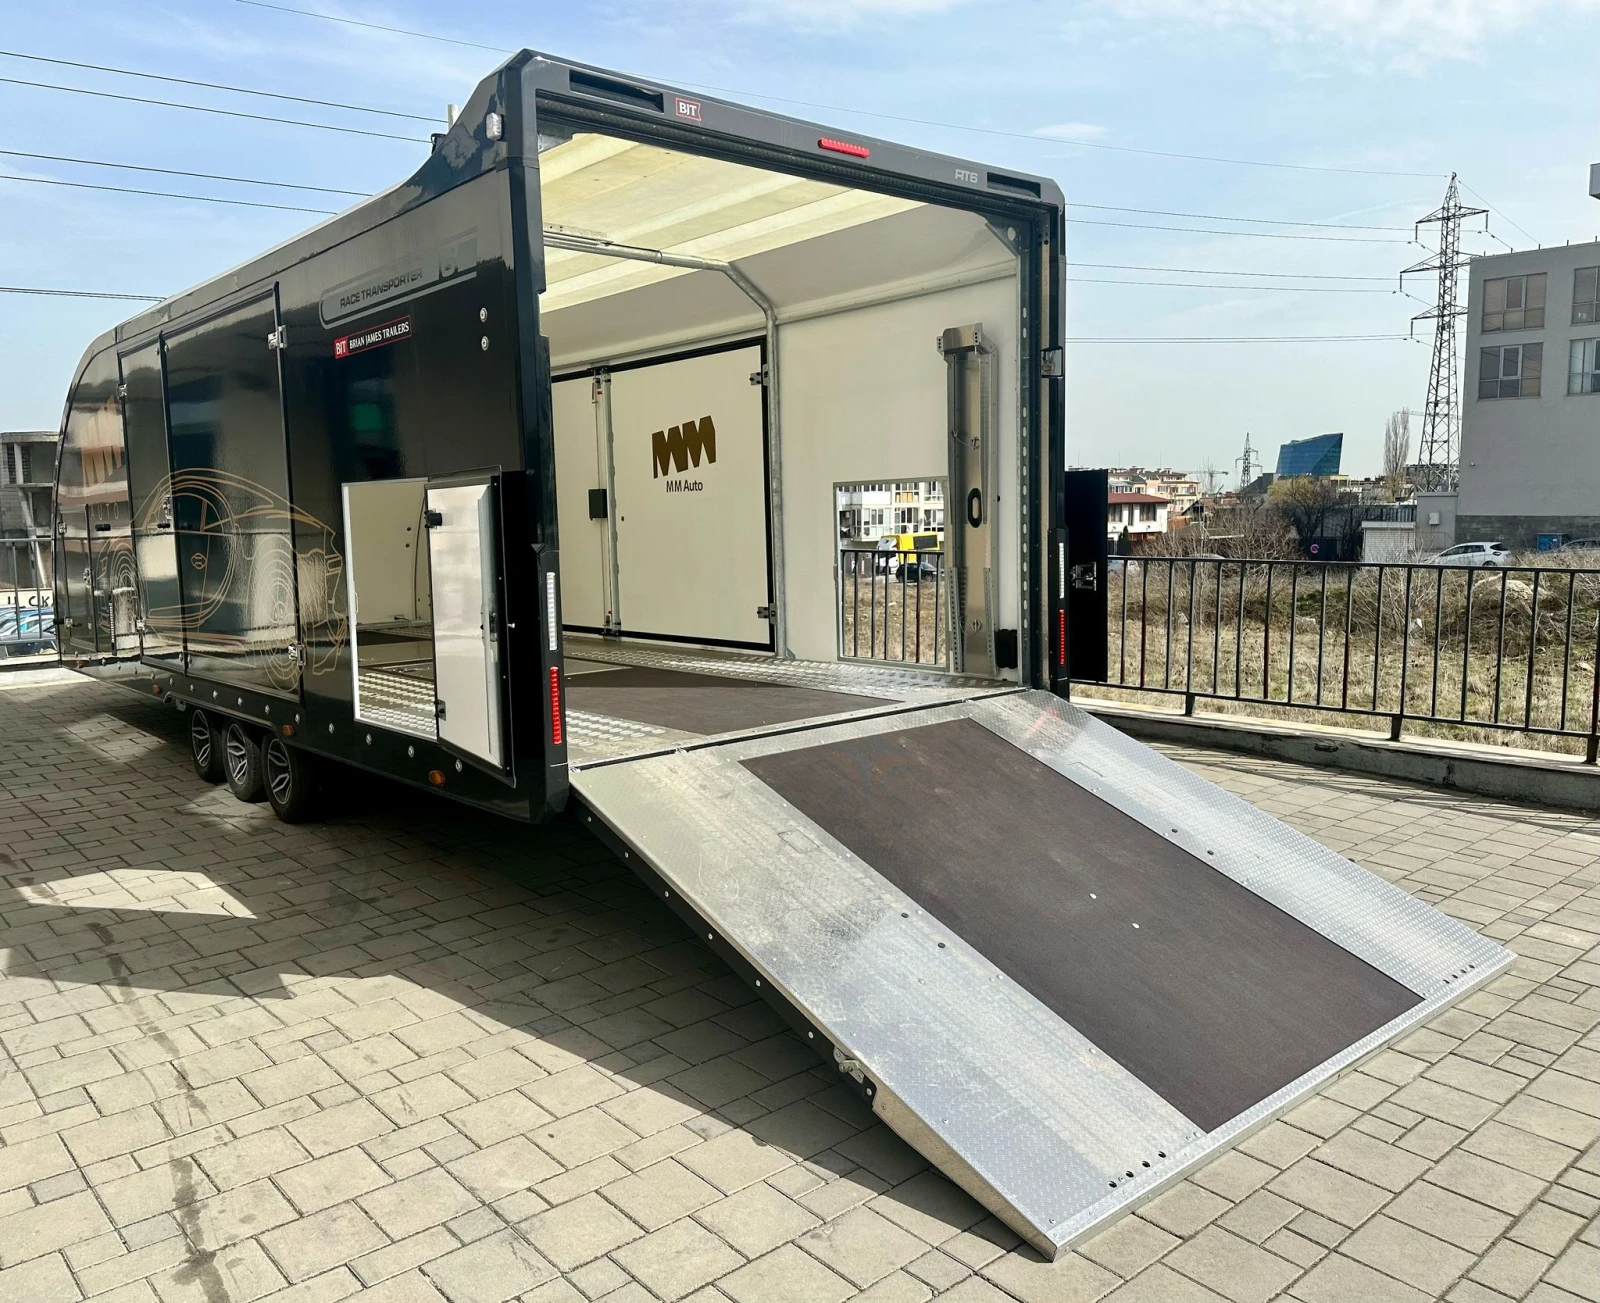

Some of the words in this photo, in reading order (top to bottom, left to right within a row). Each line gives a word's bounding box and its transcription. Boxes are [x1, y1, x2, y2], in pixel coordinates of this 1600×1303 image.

[954, 168, 979, 184] RT6
[349, 336, 365, 350] BRIAN
[365, 330, 382, 346] JAMES
[382, 321, 410, 339] TRAILERS
[666, 480, 682, 493] MM
[683, 479, 703, 492] Auto
